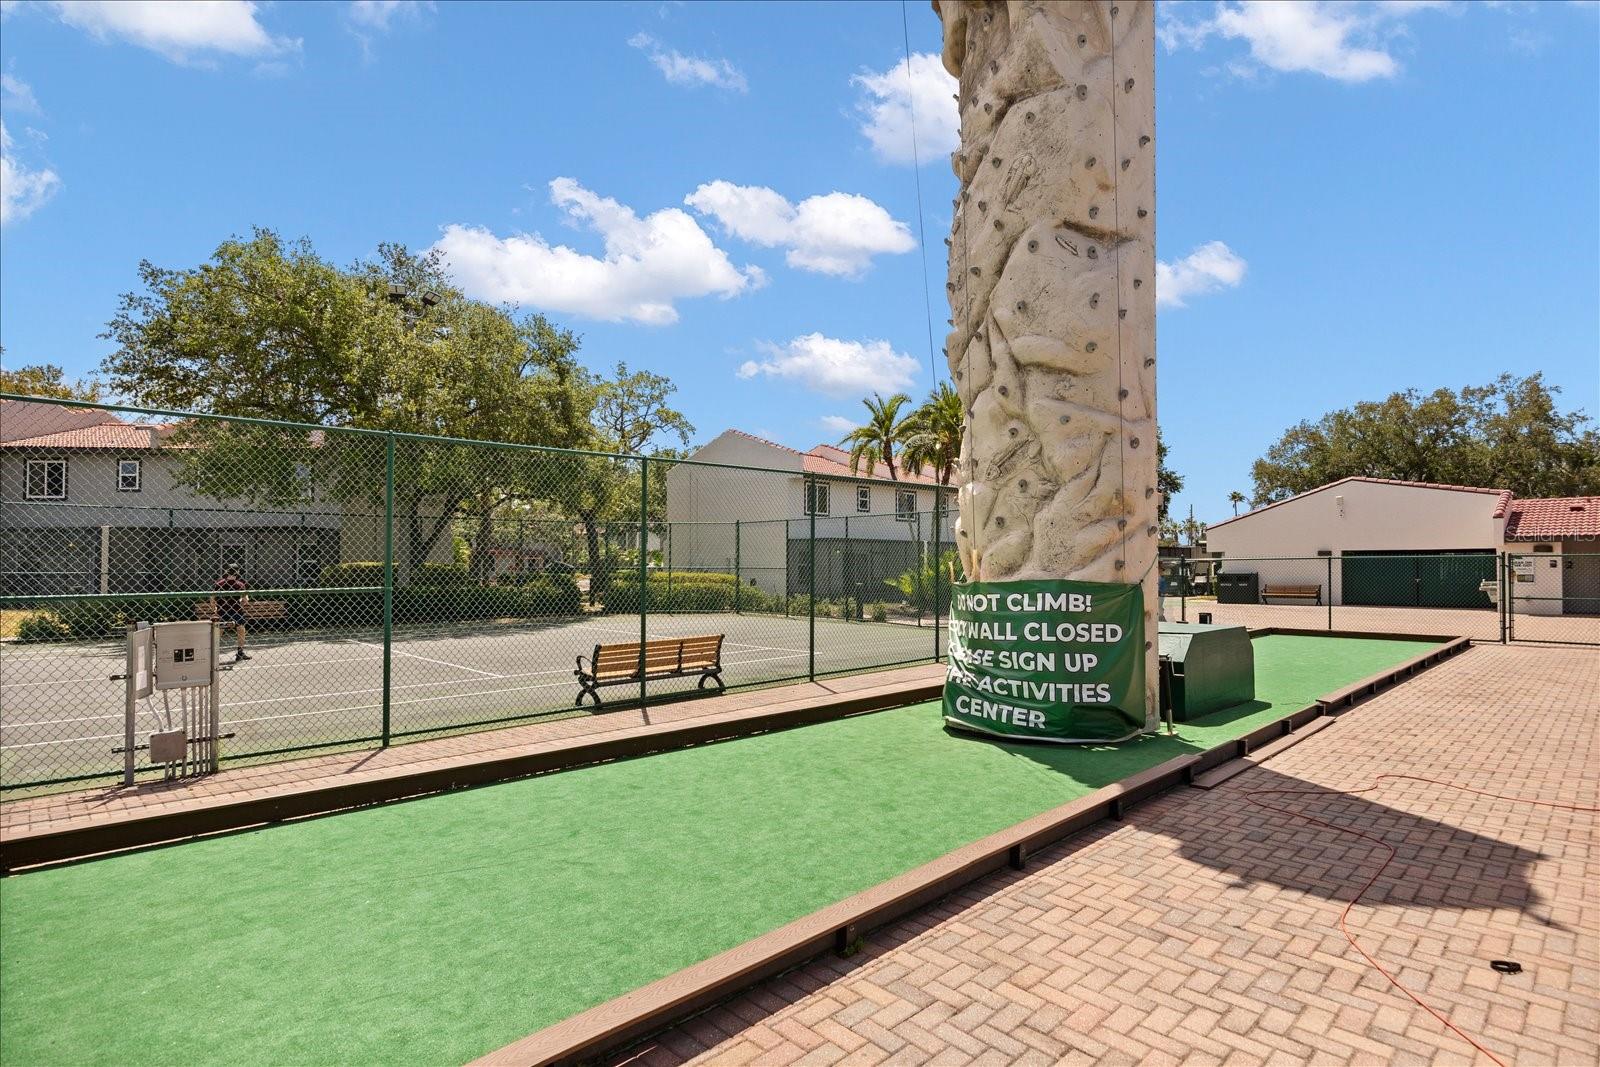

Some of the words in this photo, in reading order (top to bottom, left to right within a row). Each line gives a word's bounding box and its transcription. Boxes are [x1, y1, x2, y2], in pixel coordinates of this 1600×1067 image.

[966, 593, 1001, 612] NOT
[1006, 592, 1092, 613] CLIMB!
[1023, 622, 1123, 643] CLOSED
[998, 650, 1056, 672] SIGN
[1064, 652, 1098, 673] UP
[976, 675, 1112, 704] ACTIVITIES
[955, 695, 1046, 729] CENTER
